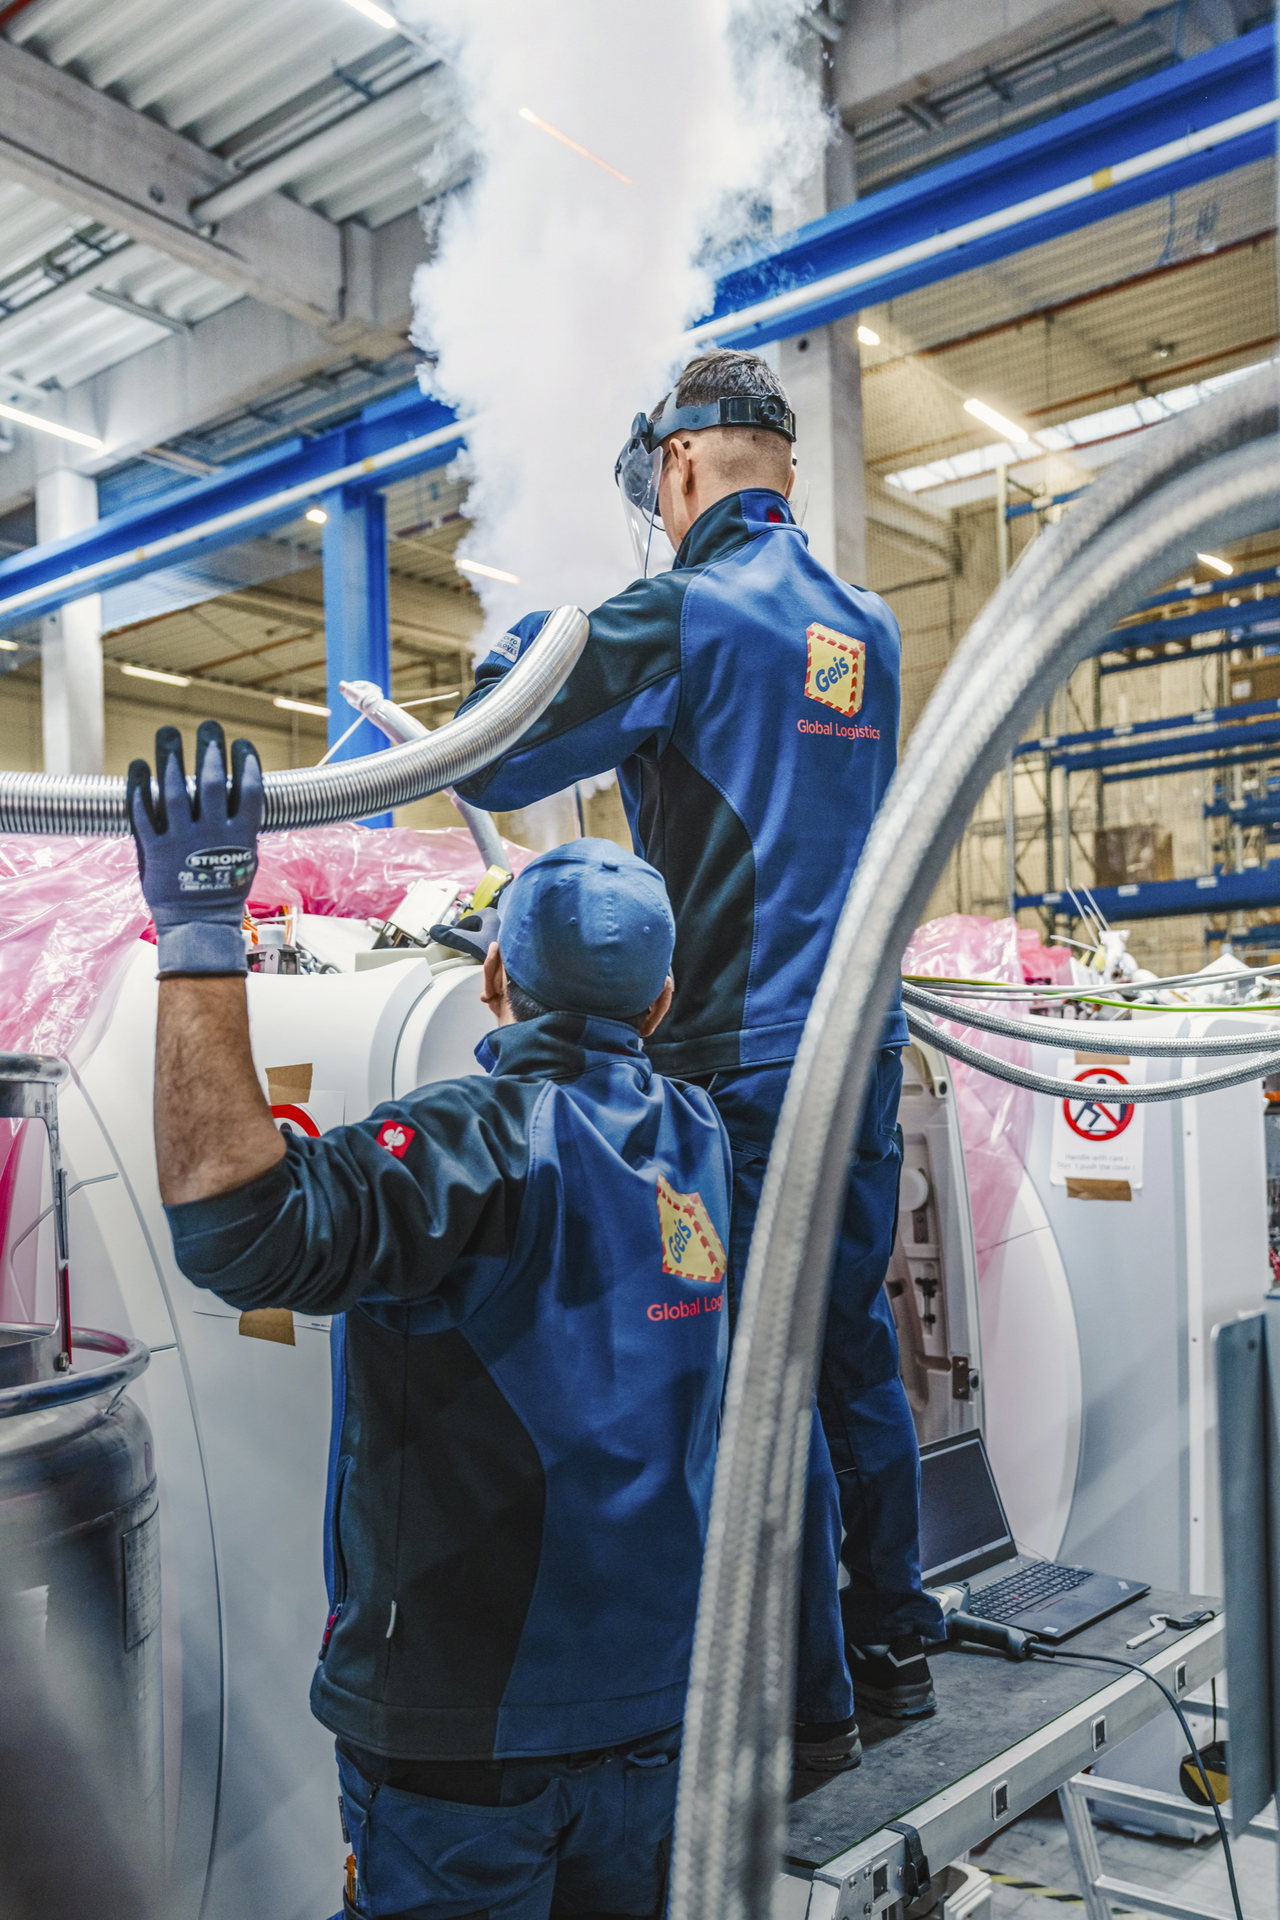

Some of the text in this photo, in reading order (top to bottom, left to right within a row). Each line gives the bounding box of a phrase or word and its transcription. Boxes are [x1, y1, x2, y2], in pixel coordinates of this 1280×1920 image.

[815, 656, 850, 693] Geis
[797, 719, 881, 740] Global Logistics
[191, 851, 252, 866] STRONG
[668, 1218, 692, 1264] Geis
[647, 1298, 700, 1322] Global
